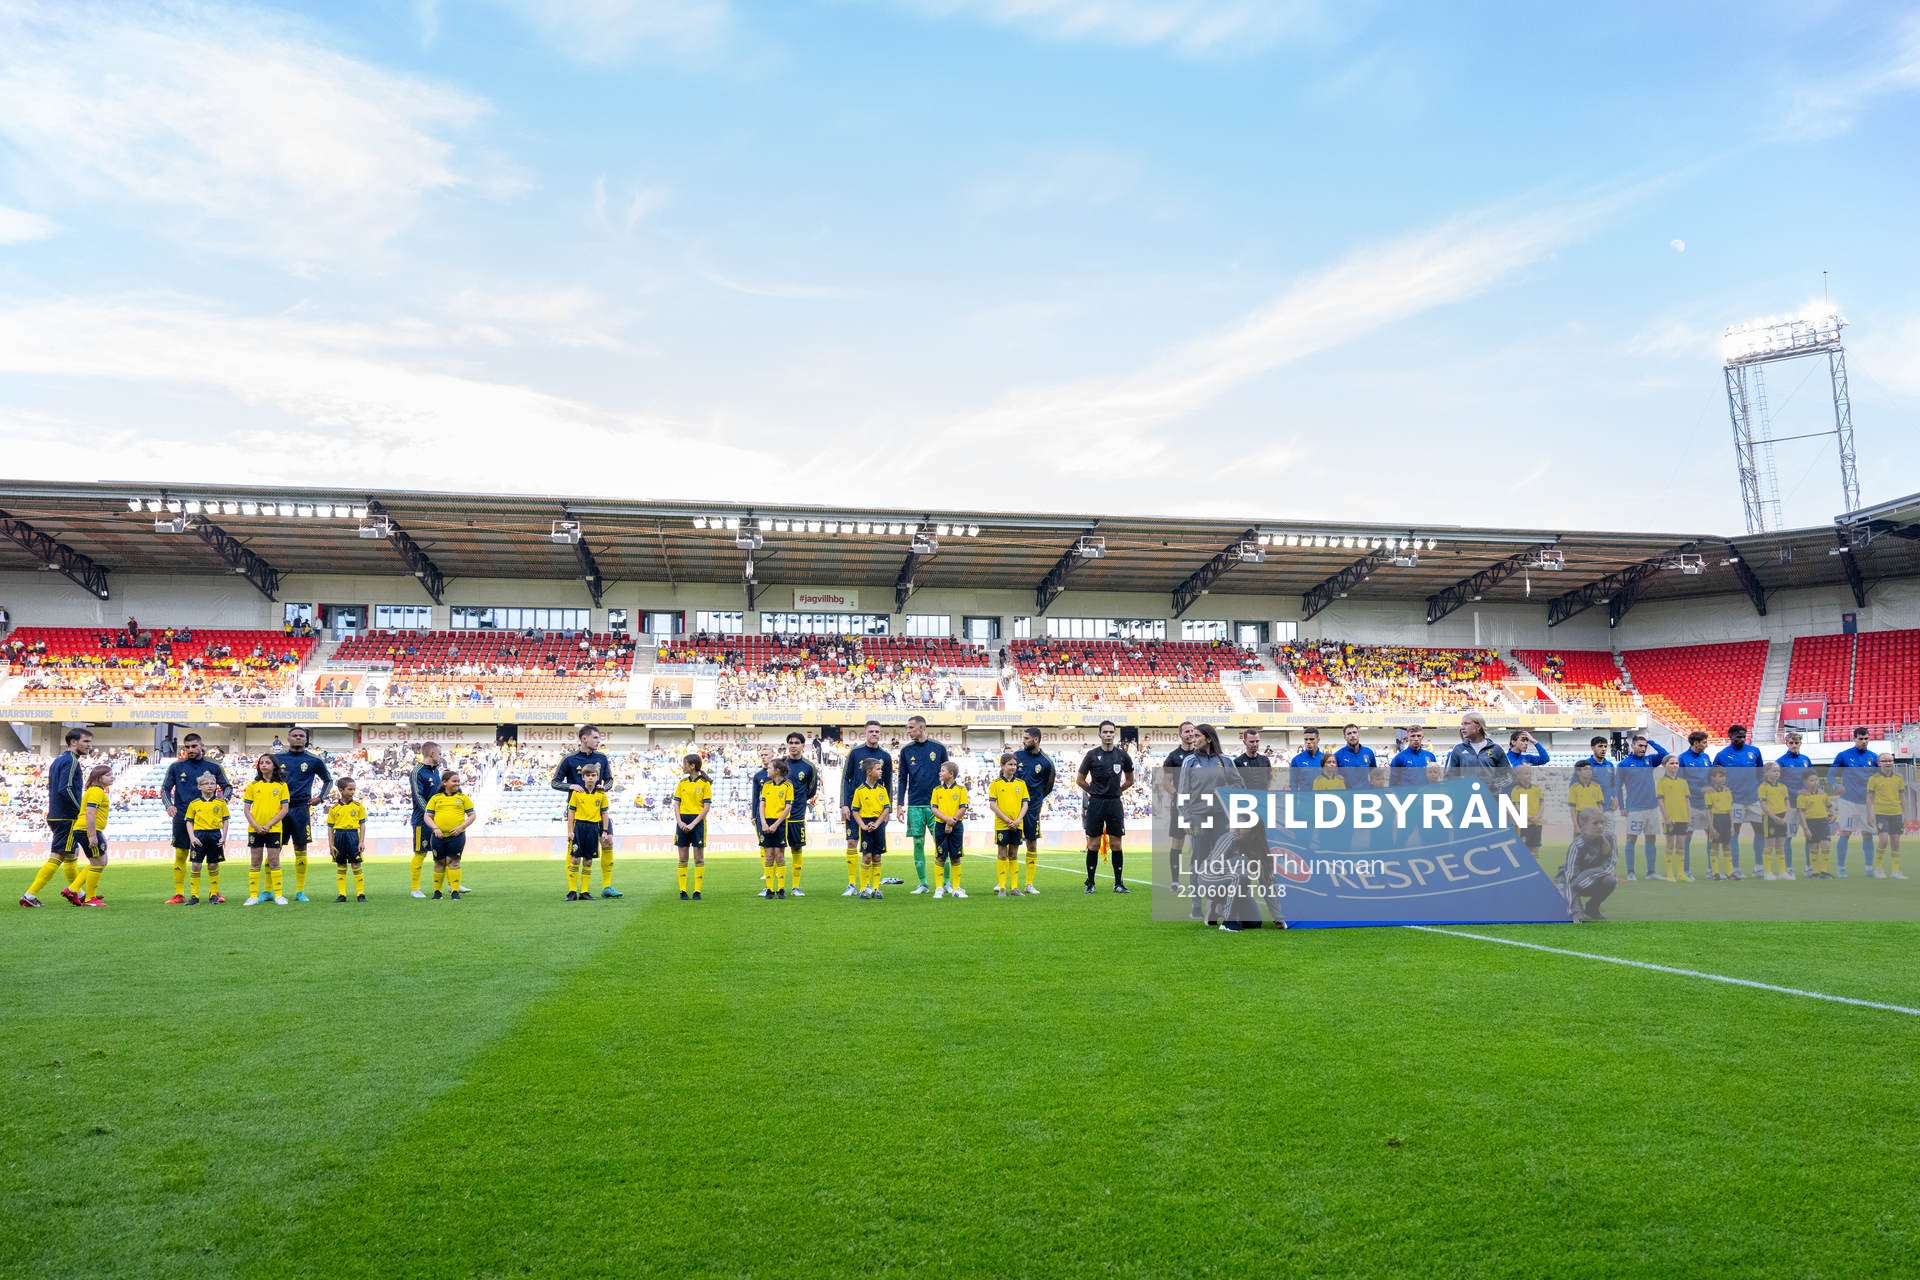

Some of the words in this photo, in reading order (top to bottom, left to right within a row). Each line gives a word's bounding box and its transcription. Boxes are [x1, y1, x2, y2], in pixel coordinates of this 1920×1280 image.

[800, 595, 845, 605] #jagvillhbg
[367, 728, 393, 741] Det
[397, 727, 413, 741] är
[417, 727, 465, 741] kärlek
[524, 728, 564, 741] ikväll
[703, 729, 729, 741] och
[733, 729, 763, 741] bror
[1061, 730, 1085, 742] och
[1733, 808, 1742, 820] 15
[1630, 820, 1644, 832] 23
[1846, 816, 1854, 828] 11
[124, 848, 142, 859] ATT
[1326, 838, 1521, 890] RESPECT
